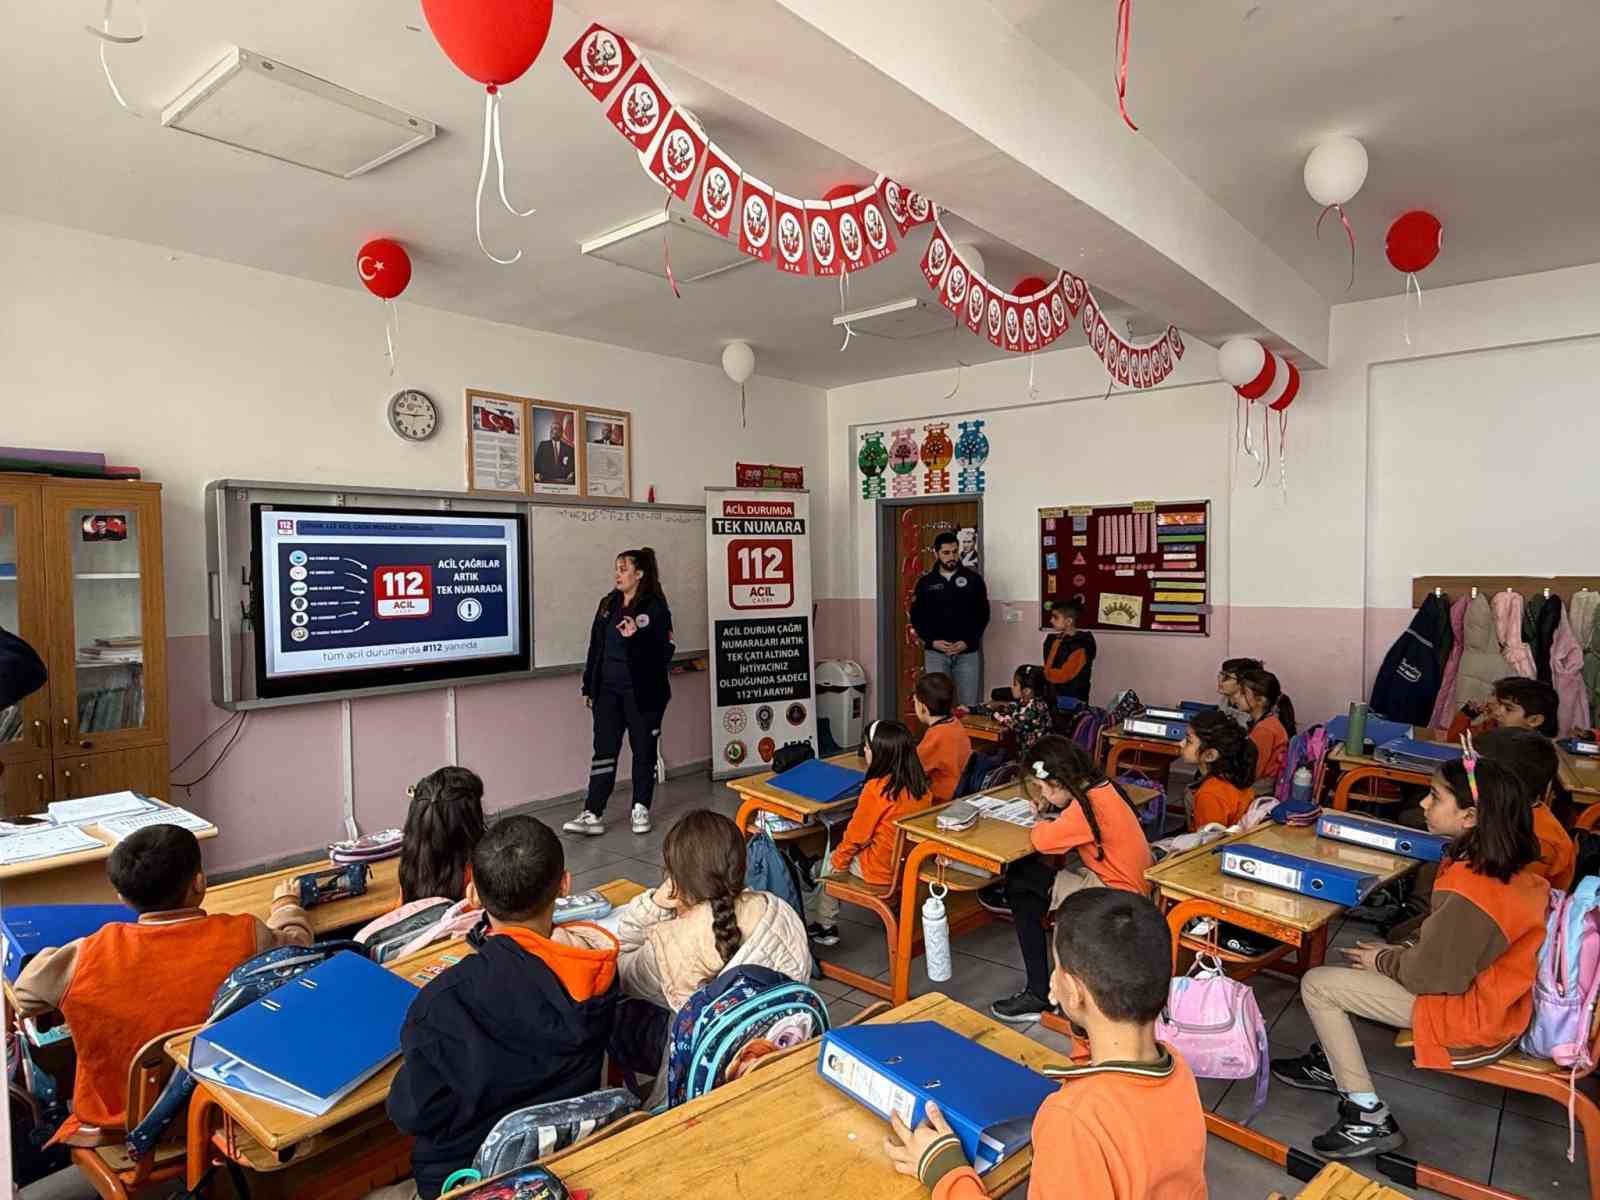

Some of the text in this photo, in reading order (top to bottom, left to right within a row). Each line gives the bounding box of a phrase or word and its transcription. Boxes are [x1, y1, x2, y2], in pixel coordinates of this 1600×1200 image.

[574, 67, 594, 90] ATA
[617, 121, 636, 142] ATA
[659, 172, 677, 190] ATA
[702, 215, 720, 230] ATA
[746, 246, 763, 258] ATA
[877, 248, 890, 259] ATA
[784, 263, 800, 272] ATA
[820, 267, 834, 275] ATA
[851, 261, 864, 270] ATA
[725, 503, 793, 515] ACİL DURUMDA
[280, 520, 293, 529] 112
[715, 520, 802, 533] TEK NUMARA
[438, 557, 501, 570] ACİL ÇAĞRILAR
[737, 547, 784, 579] 112
[453, 572, 479, 581] ARTIK
[382, 571, 424, 596] 112
[436, 584, 503, 595] TEK NUMARADA
[723, 622, 802, 637] ACİL DURUM ÇAĞRI
[721, 636, 804, 649] NUMARALARI ARTIK
[323, 651, 344, 662] tüm
[366, 646, 420, 658] durumlarda
[422, 643, 442, 652] #112
[445, 641, 478, 653] yanında
[727, 648, 800, 662] TEK ÇATI ALTINDA
[740, 662, 789, 673] İHTİYACINIZ
[719, 672, 808, 688] OLDUĞUNDA SADECE
[763, 686, 794, 697] ARAYIN
